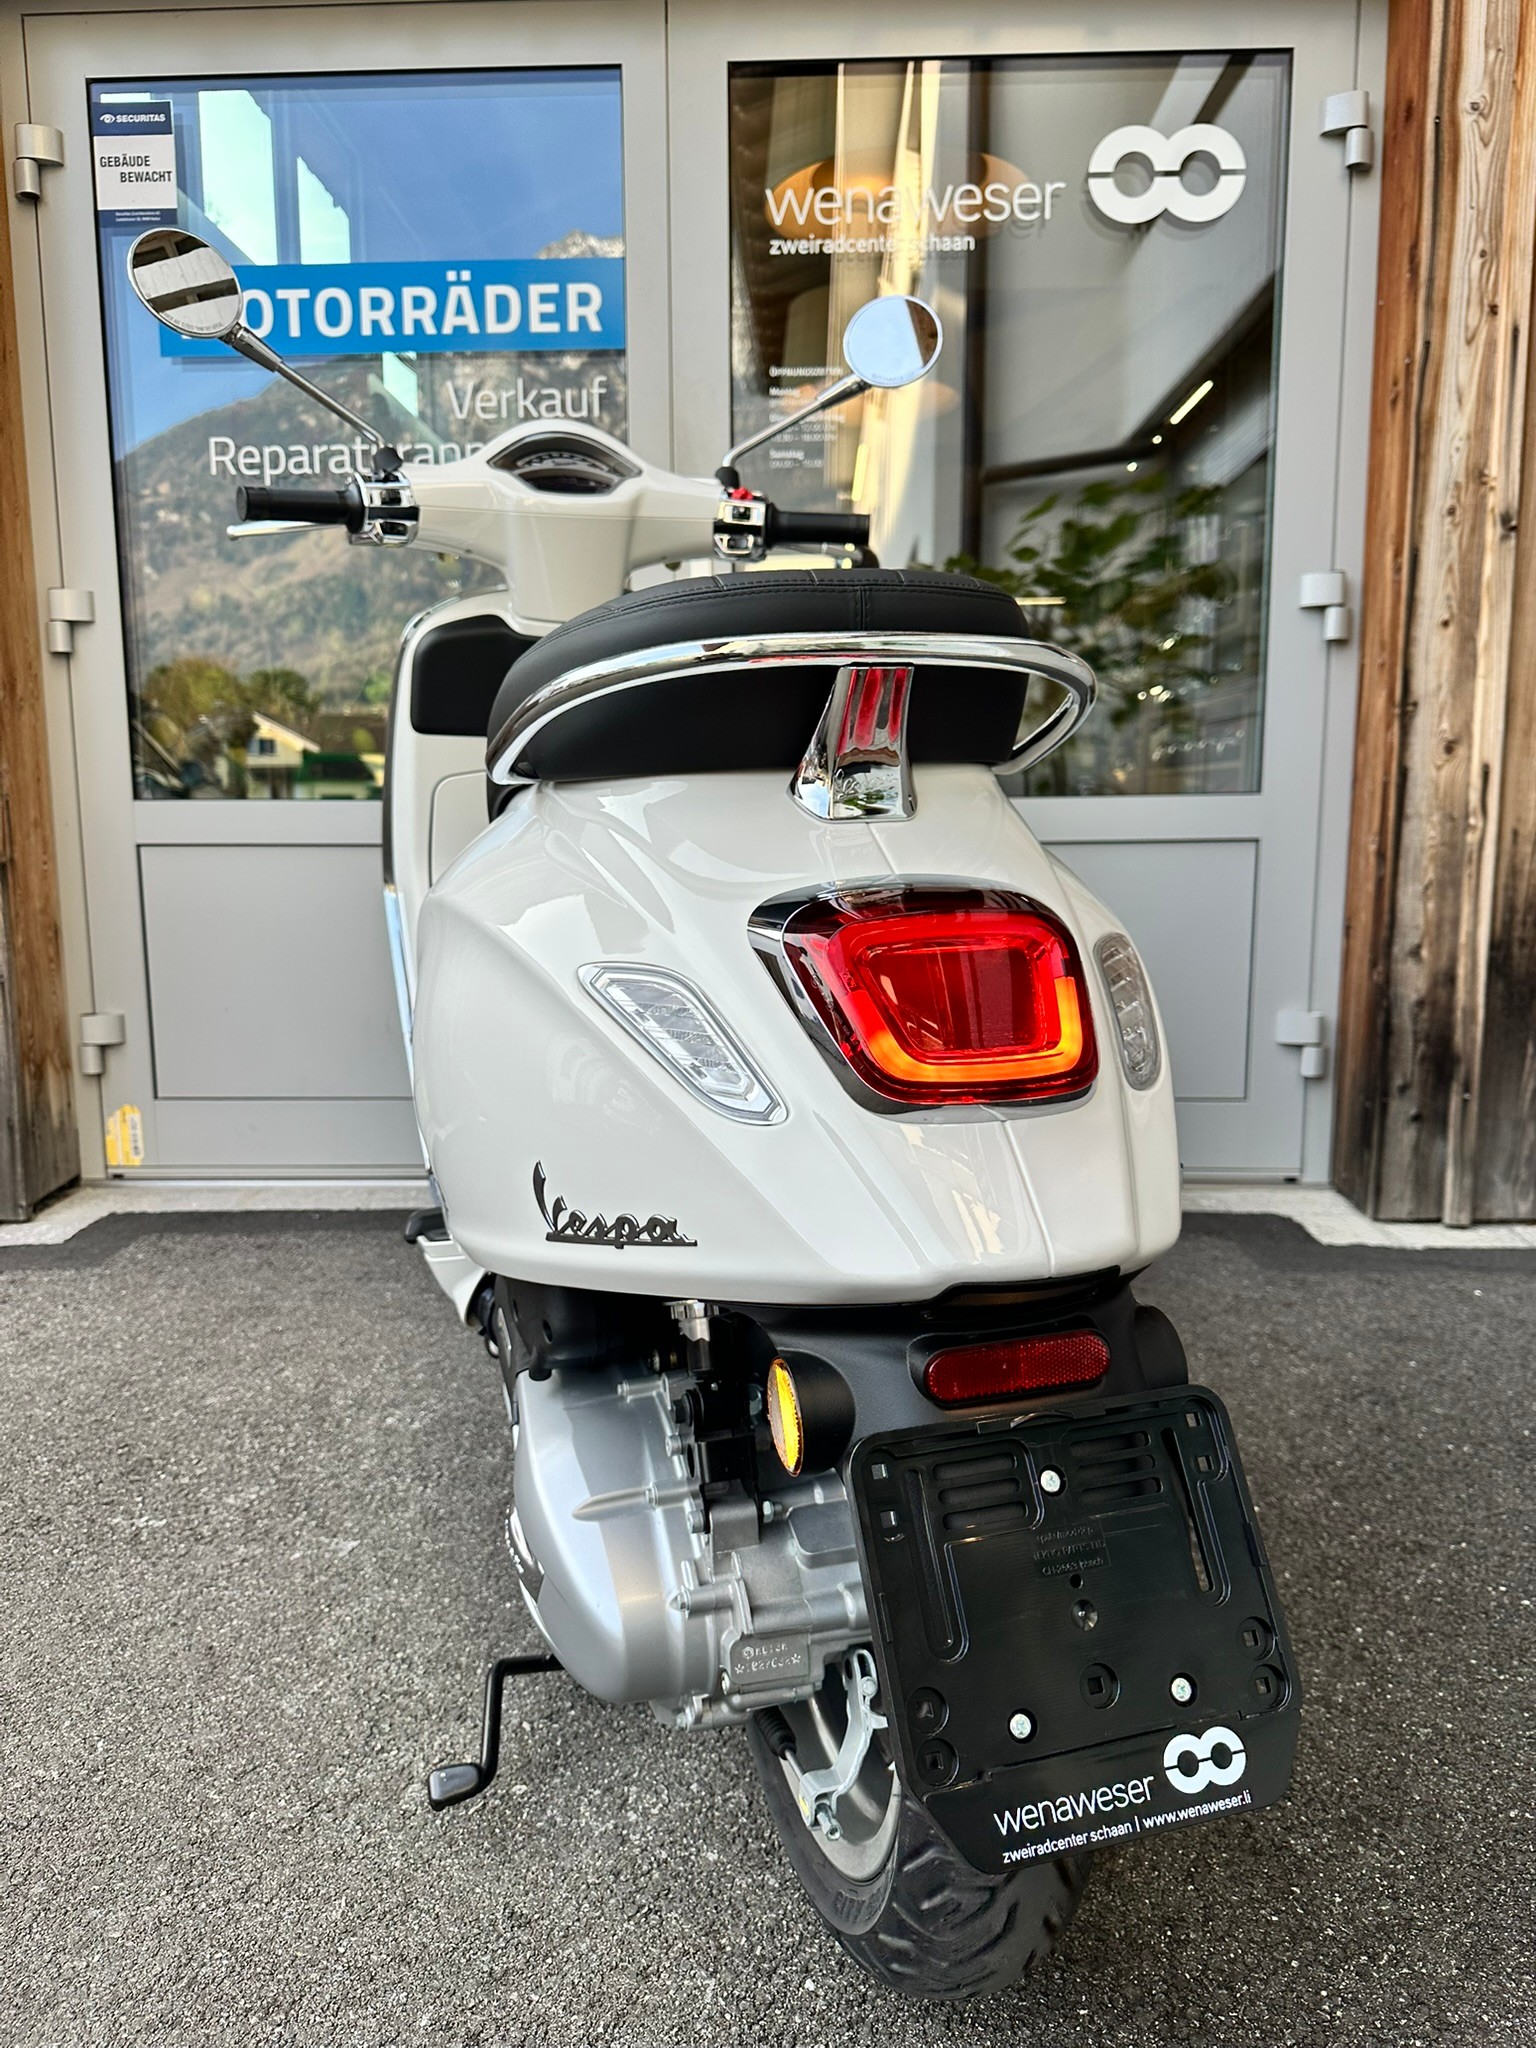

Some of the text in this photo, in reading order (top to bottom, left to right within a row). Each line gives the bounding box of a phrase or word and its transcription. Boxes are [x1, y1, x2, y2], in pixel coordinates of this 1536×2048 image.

[116, 114, 166, 122] SECURITAS
[100, 153, 151, 167] GEBÄUDE
[120, 171, 172, 182] BEWACHT
[765, 181, 1067, 226] wenaweser
[181, 270, 603, 339] OTORRÄDER
[446, 376, 607, 420] Verkauf
[533, 1160, 698, 1250] Vespa
[993, 1775, 1155, 1836] wenaweser
[1002, 1789, 1252, 1864] zweiradcenter schaan www.wenaweser.li
